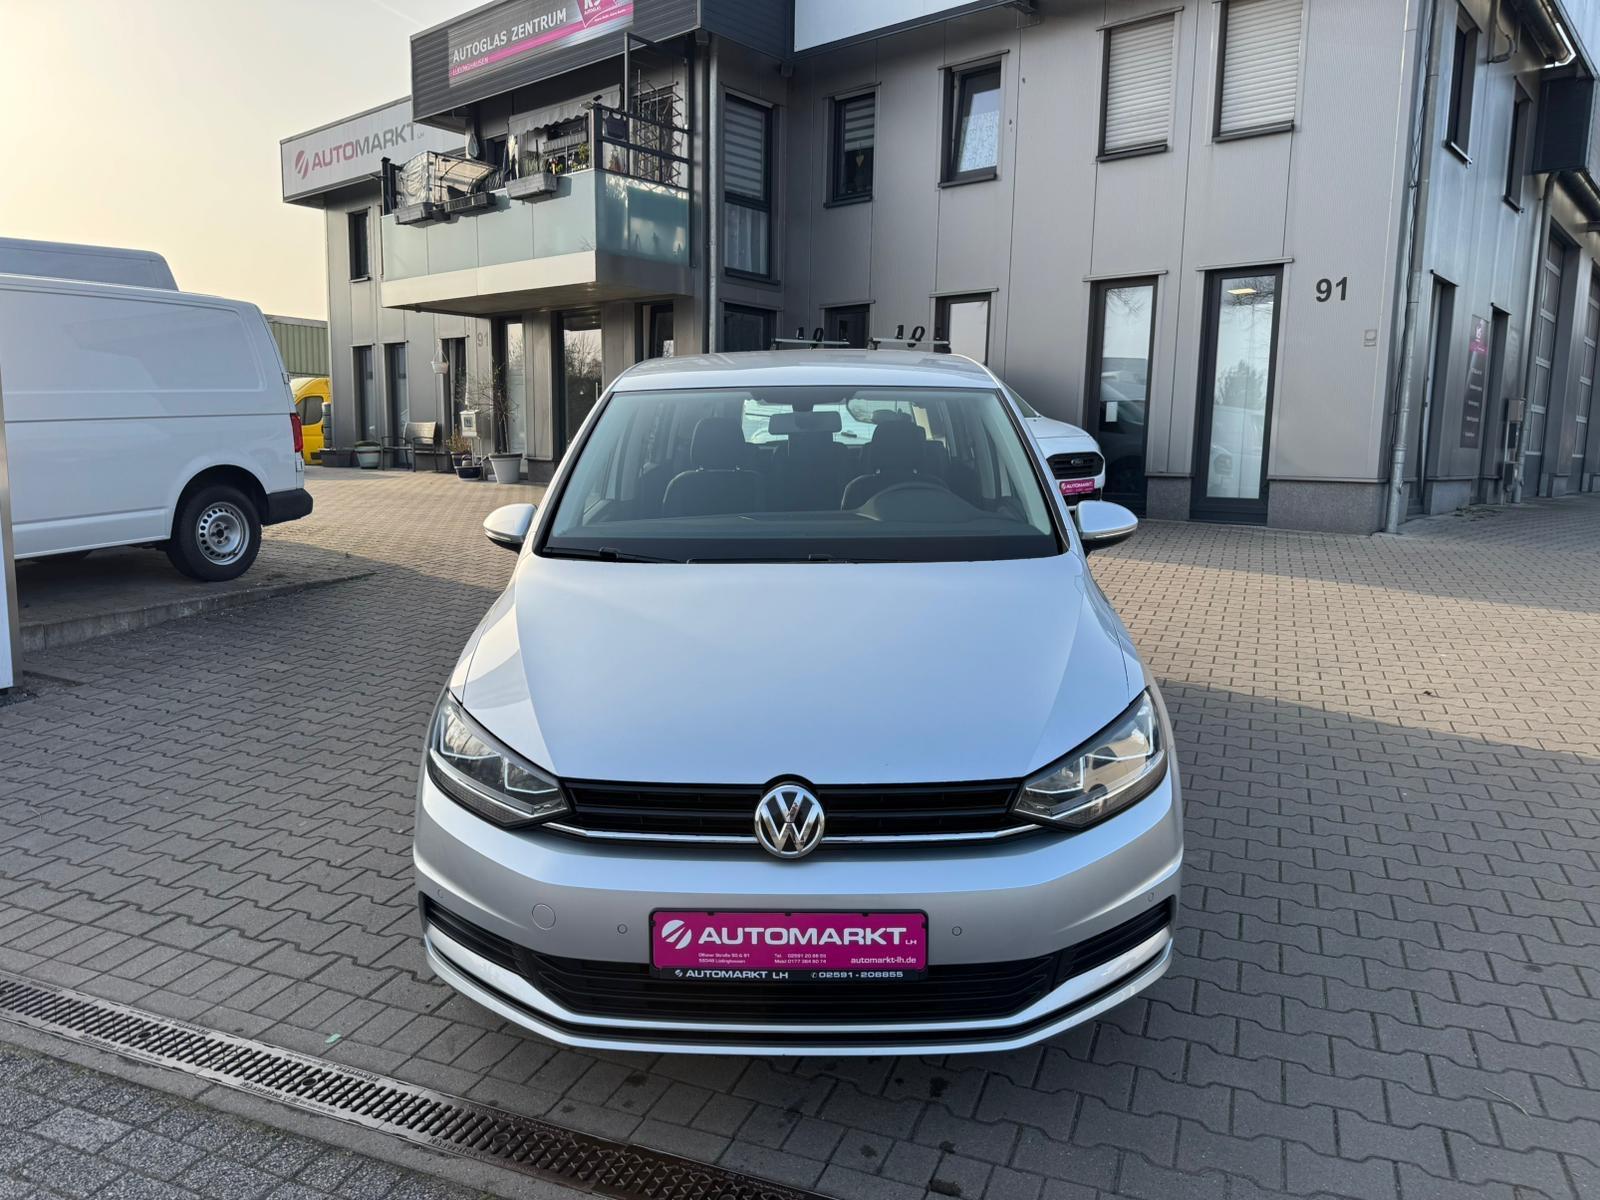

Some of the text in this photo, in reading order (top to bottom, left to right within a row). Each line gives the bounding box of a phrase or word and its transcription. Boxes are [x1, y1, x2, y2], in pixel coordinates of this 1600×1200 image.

[452, 30, 507, 64] AUTOGLAS
[511, 8, 567, 41] ZENTRUM
[311, 122, 417, 171] AUTOMARKT
[1315, 276, 1348, 303] 91
[477, 332, 489, 348] 91
[698, 927, 907, 945] AUTOMARKT
[850, 956, 917, 964] automarkt-lh.de
[686, 970, 789, 979] AUTOMARKT LH
